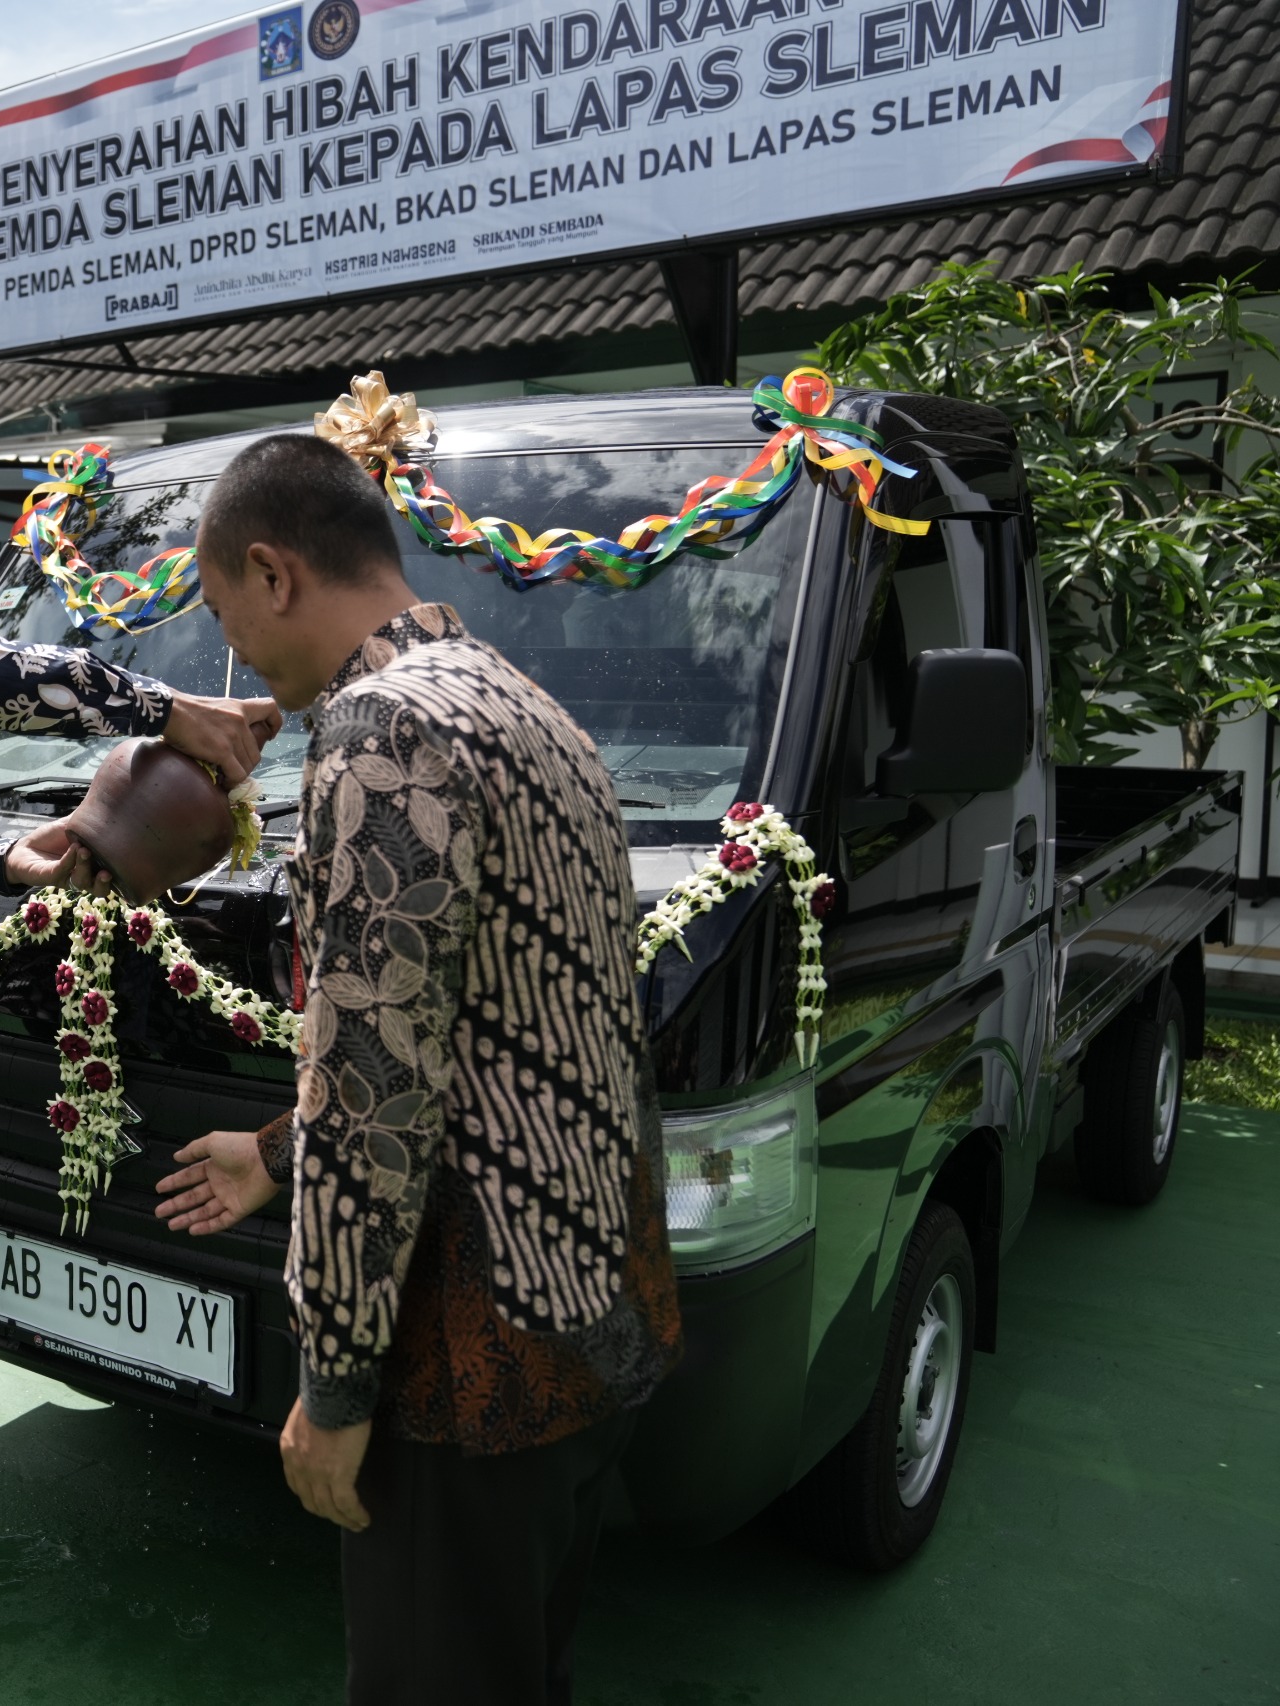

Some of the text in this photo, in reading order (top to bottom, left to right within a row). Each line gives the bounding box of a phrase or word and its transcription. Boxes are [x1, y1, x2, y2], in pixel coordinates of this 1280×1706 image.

[264, 53, 419, 143] HIBAH
[438, 0, 843, 102] KENDARA
[102, 151, 283, 237] SLEMAN
[300, 100, 517, 198] KEPADA
[532, 46, 742, 148] LAPAS
[5, 266, 75, 300] PEMDA
[82, 243, 182, 284] SLEMAN,
[191, 228, 256, 264] DPRD
[266, 204, 386, 249] SLEMAN,
[396, 184, 477, 225] BKAD
[489, 154, 625, 207] SLEMAN
[639, 136, 713, 181] DAN
[728, 109, 856, 164] LAPAS
[871, 64, 1062, 136] SLEMAN
[473, 213, 604, 247] SRIKANDI SEMBADA
[517, 238, 546, 250] Tangguh
[278, 266, 312, 282] Karya
[1, 1245, 219, 1353] AB 1590 XY
[44, 1339, 97, 1364] SEJAHTERA
[99, 1357, 142, 1378] SUNINDO
[144, 1371, 177, 1390] TRADA
